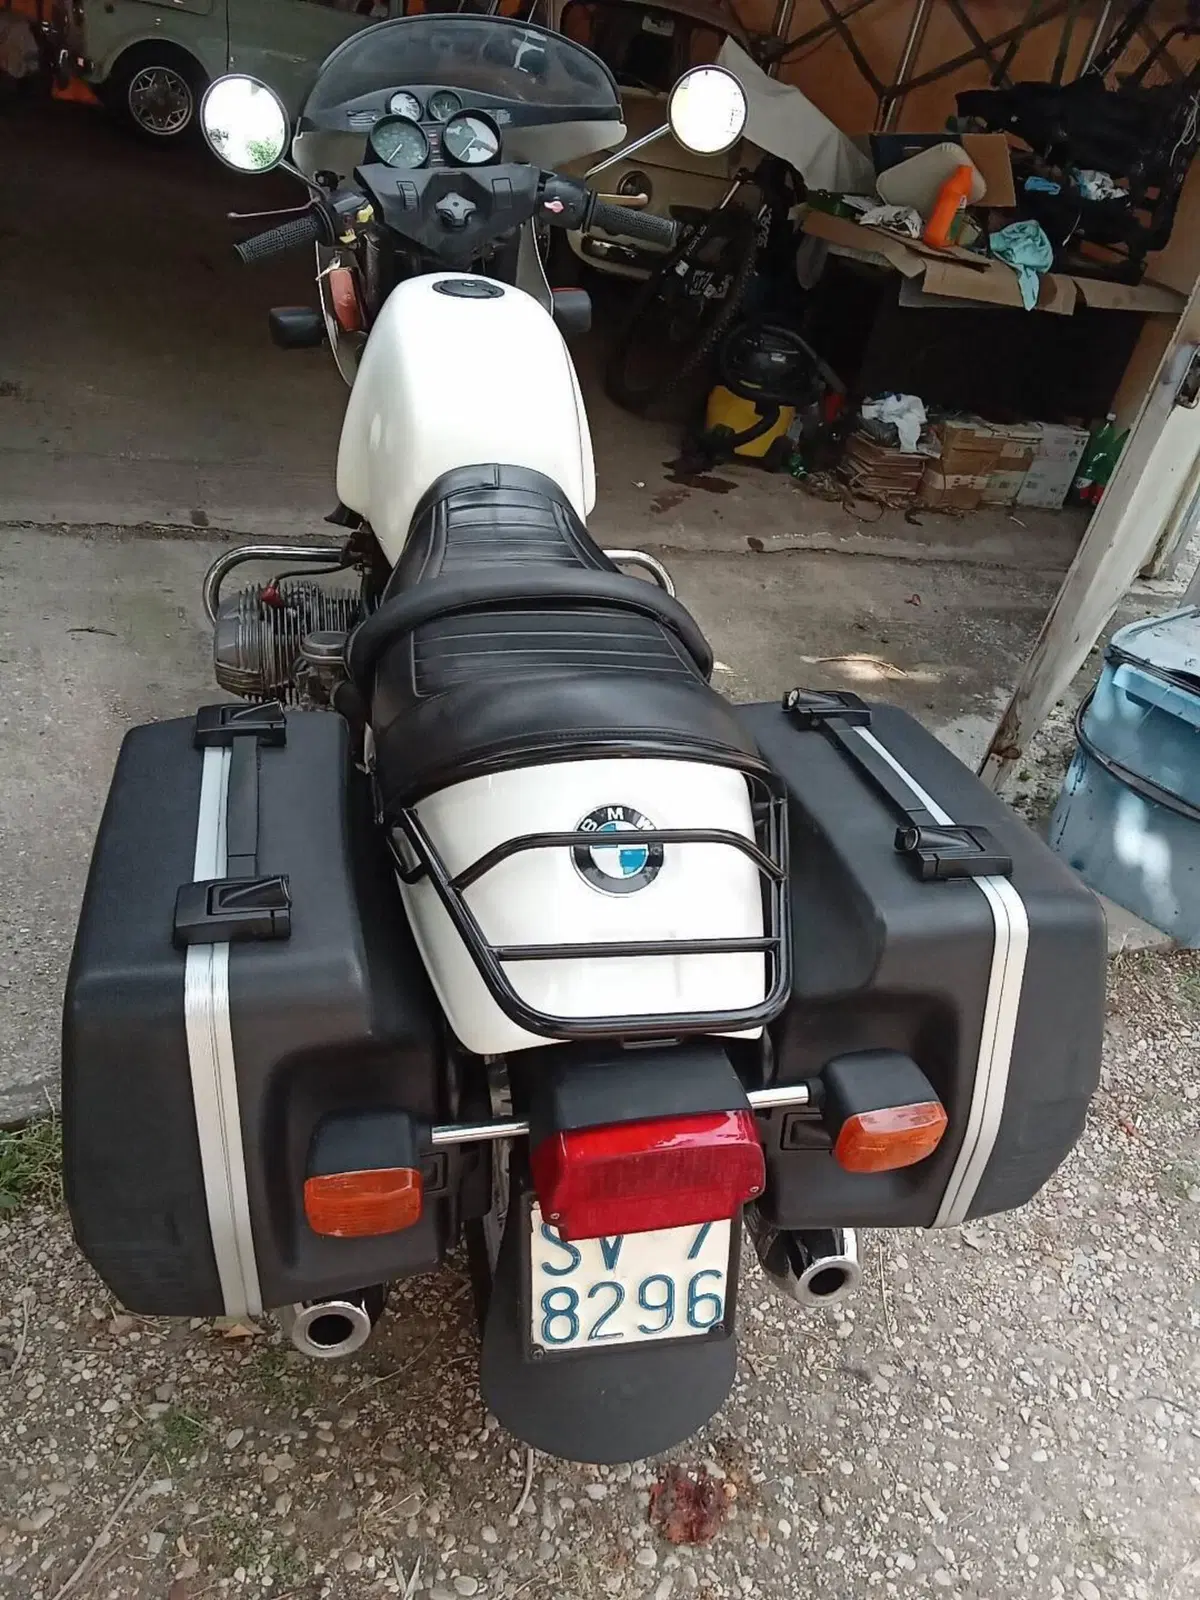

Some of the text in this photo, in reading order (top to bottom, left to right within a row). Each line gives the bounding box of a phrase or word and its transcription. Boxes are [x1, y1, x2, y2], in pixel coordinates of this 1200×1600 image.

[579, 807, 656, 832] BMW
[540, 1222, 624, 1276] SV
[540, 1269, 723, 1344] 8296
